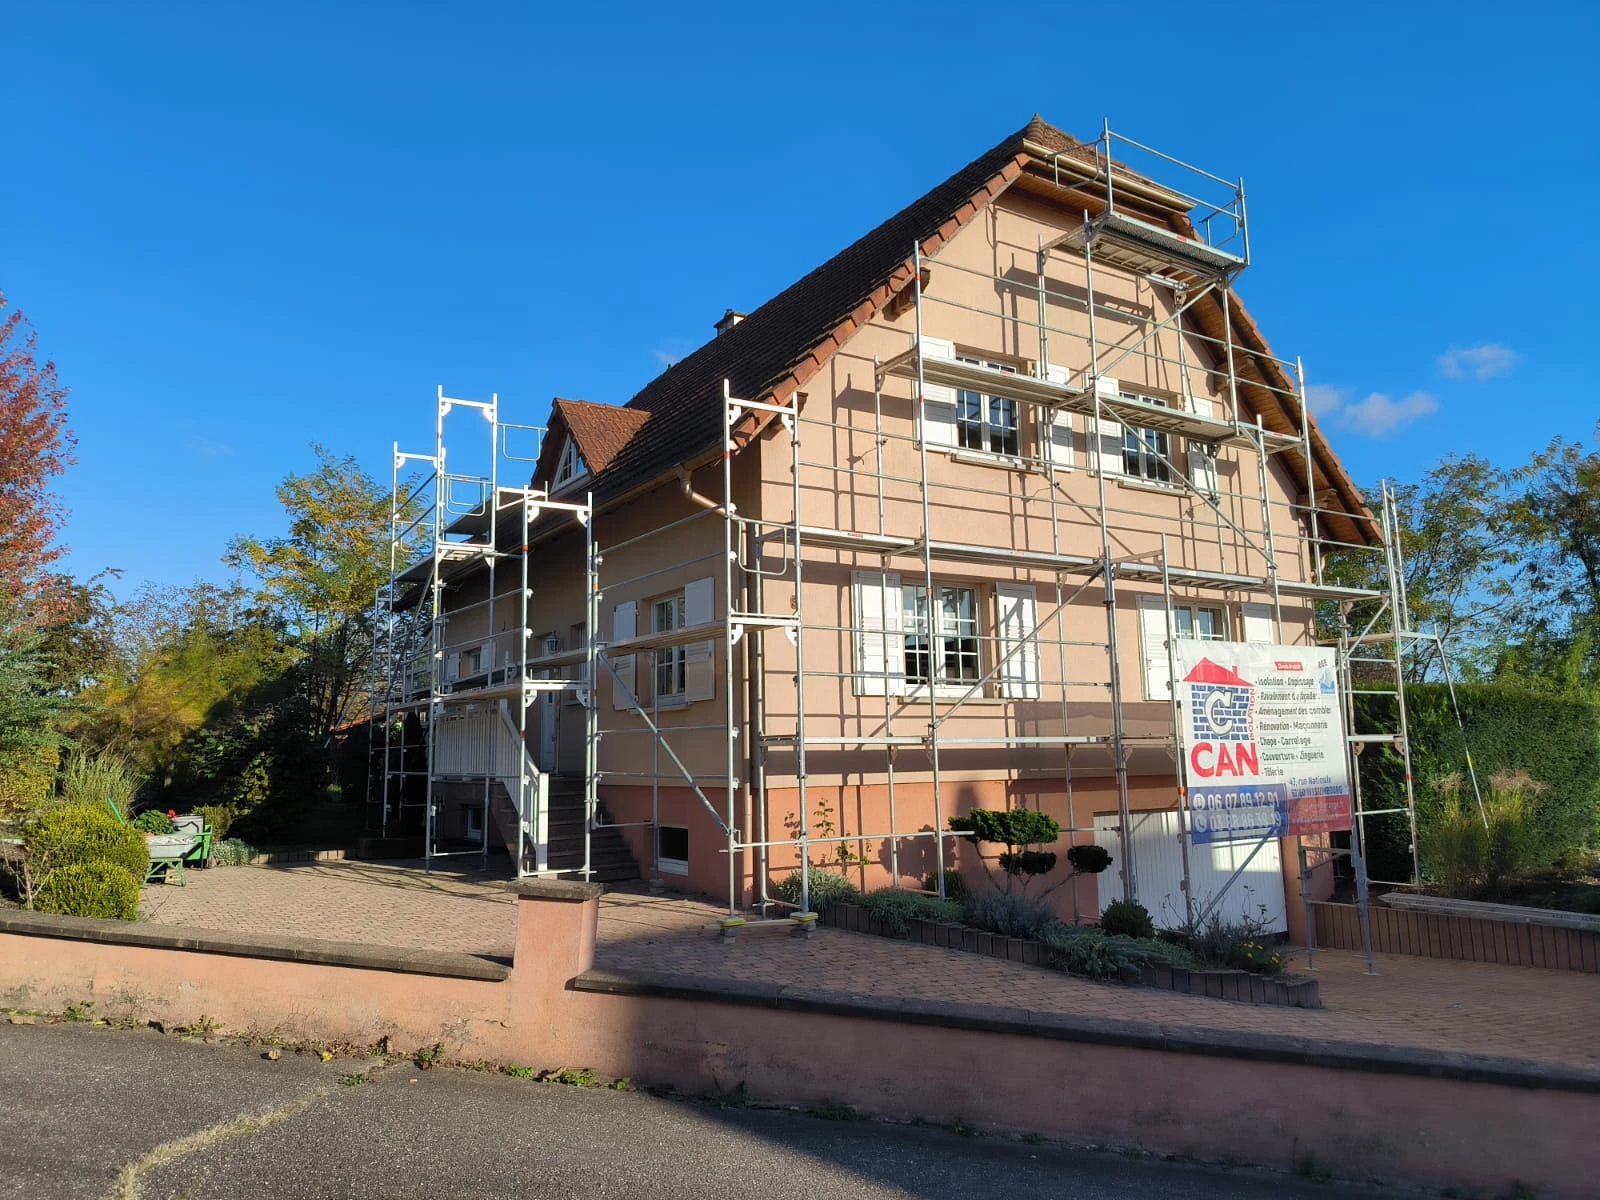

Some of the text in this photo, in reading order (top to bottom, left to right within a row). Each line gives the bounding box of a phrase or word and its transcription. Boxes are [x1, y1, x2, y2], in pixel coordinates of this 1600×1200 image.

[1204, 688, 1233, 737] C
[1259, 721, 1289, 731] Rénovation
[1260, 736, 1311, 747] Chape Carrelage
[1191, 742, 1259, 777] CAN
[1262, 752, 1295, 761] Couverture
[1208, 794, 1222, 810] 06
[1225, 793, 1237, 809] 07
[1240, 792, 1253, 808] 89
[1254, 792, 1265, 808] 12
[1267, 791, 1280, 808] 91
